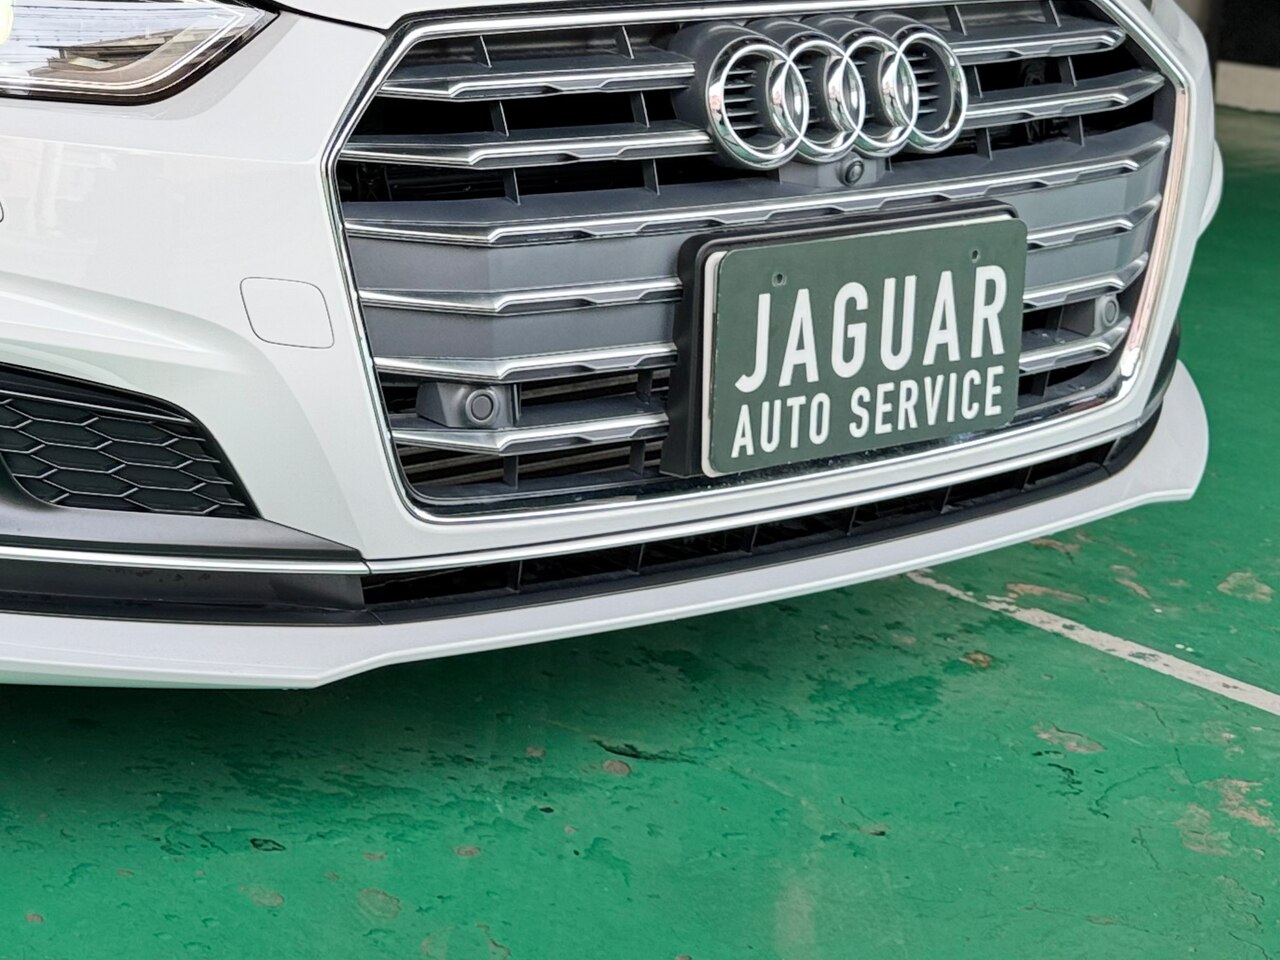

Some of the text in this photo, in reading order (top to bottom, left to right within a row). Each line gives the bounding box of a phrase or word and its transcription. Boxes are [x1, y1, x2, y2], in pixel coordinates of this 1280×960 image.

[734, 264, 1008, 393] JAGUAR
[730, 365, 1005, 458] AUTO SERVICE
